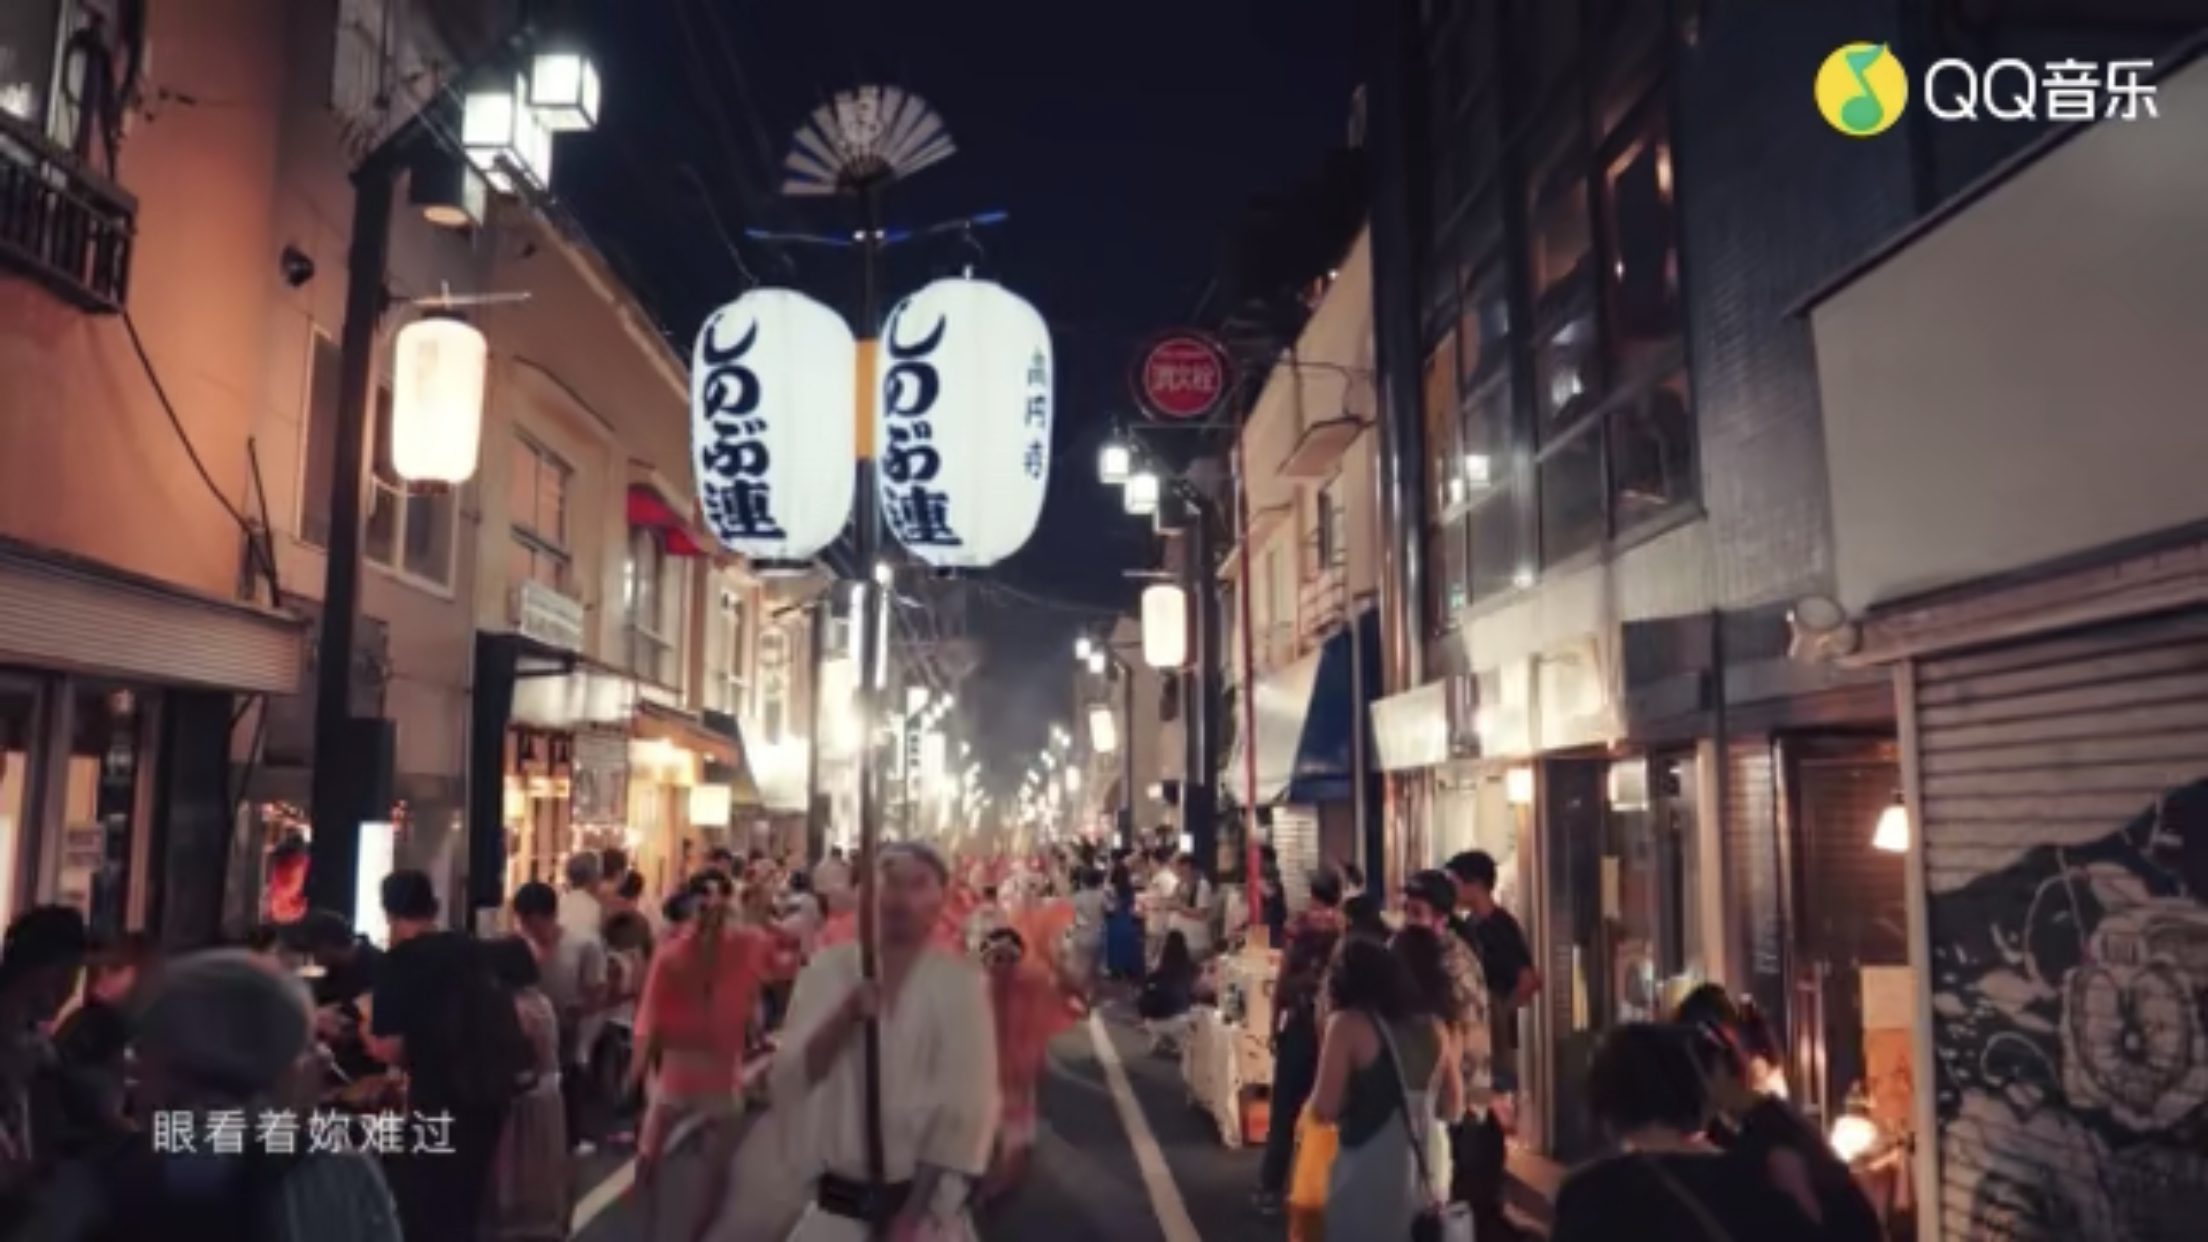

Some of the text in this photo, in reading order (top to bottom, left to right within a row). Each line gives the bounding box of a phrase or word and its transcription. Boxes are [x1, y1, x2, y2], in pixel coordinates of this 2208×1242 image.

[702, 313, 787, 540] しのぶ連
[883, 299, 963, 546] しのぶ連
